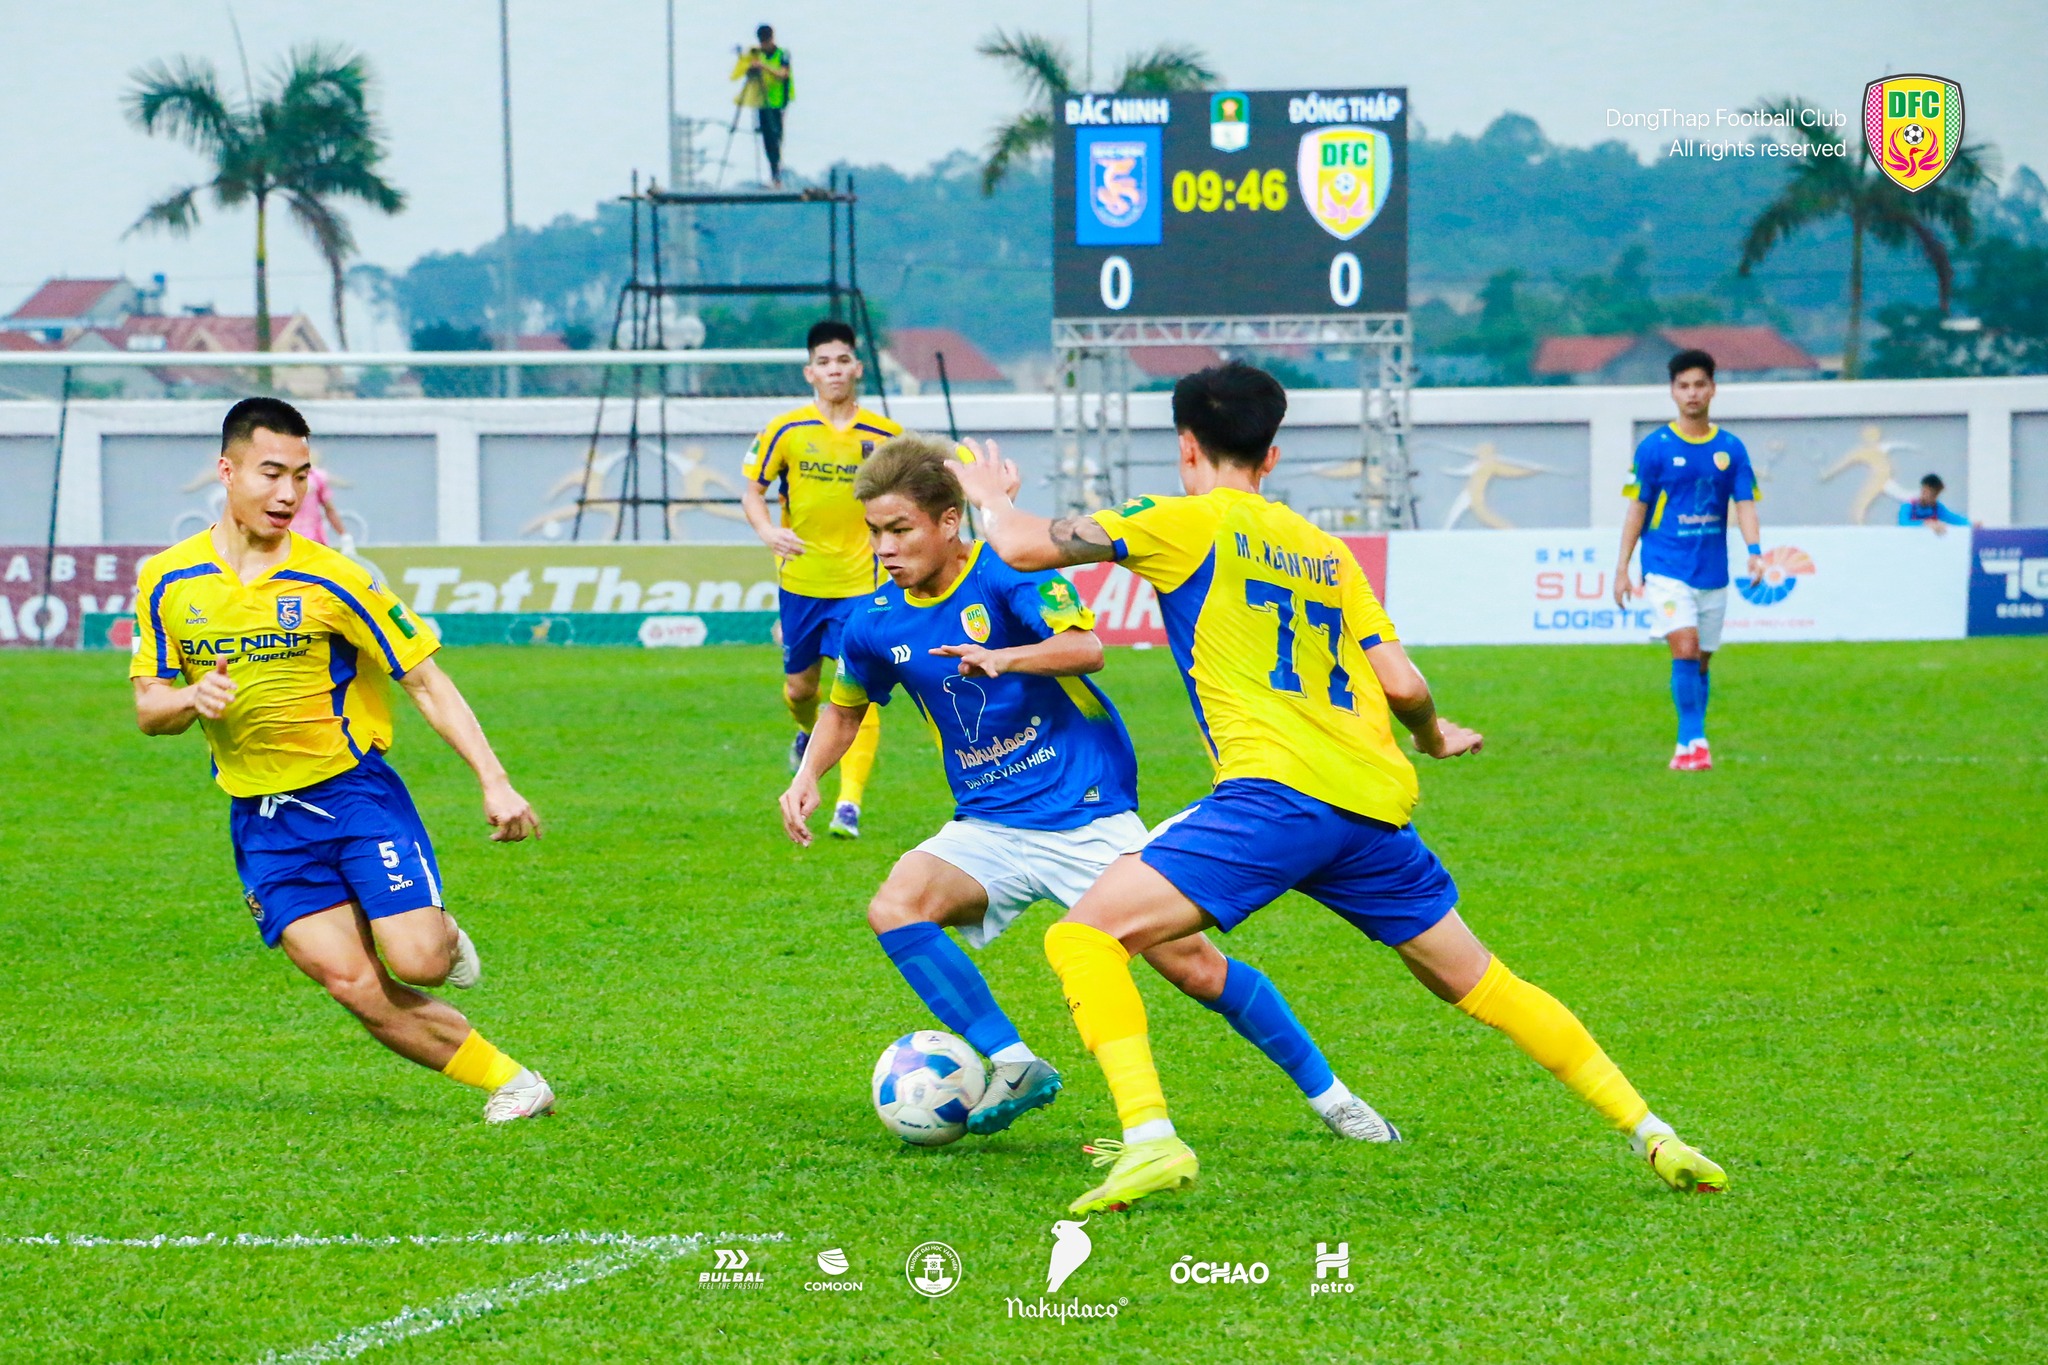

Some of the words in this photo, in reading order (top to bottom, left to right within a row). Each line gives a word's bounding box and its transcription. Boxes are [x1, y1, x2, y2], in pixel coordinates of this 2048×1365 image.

[1112, 98, 1169, 124] NINH
[1322, 143, 1368, 167] DFC
[1172, 169, 1288, 213] 09:46
[1100, 255, 1133, 310] 0
[1329, 252, 1362, 307] 0
[799, 461, 833, 474] BAC
[836, 464, 858, 474] NI
[966, 608, 981, 621] DFC
[180, 638, 235, 655] BAC
[186, 656, 241, 667] Stroner
[247, 649, 310, 663] Together
[1245, 578, 1359, 717] 77
[378, 841, 400, 869] 5
